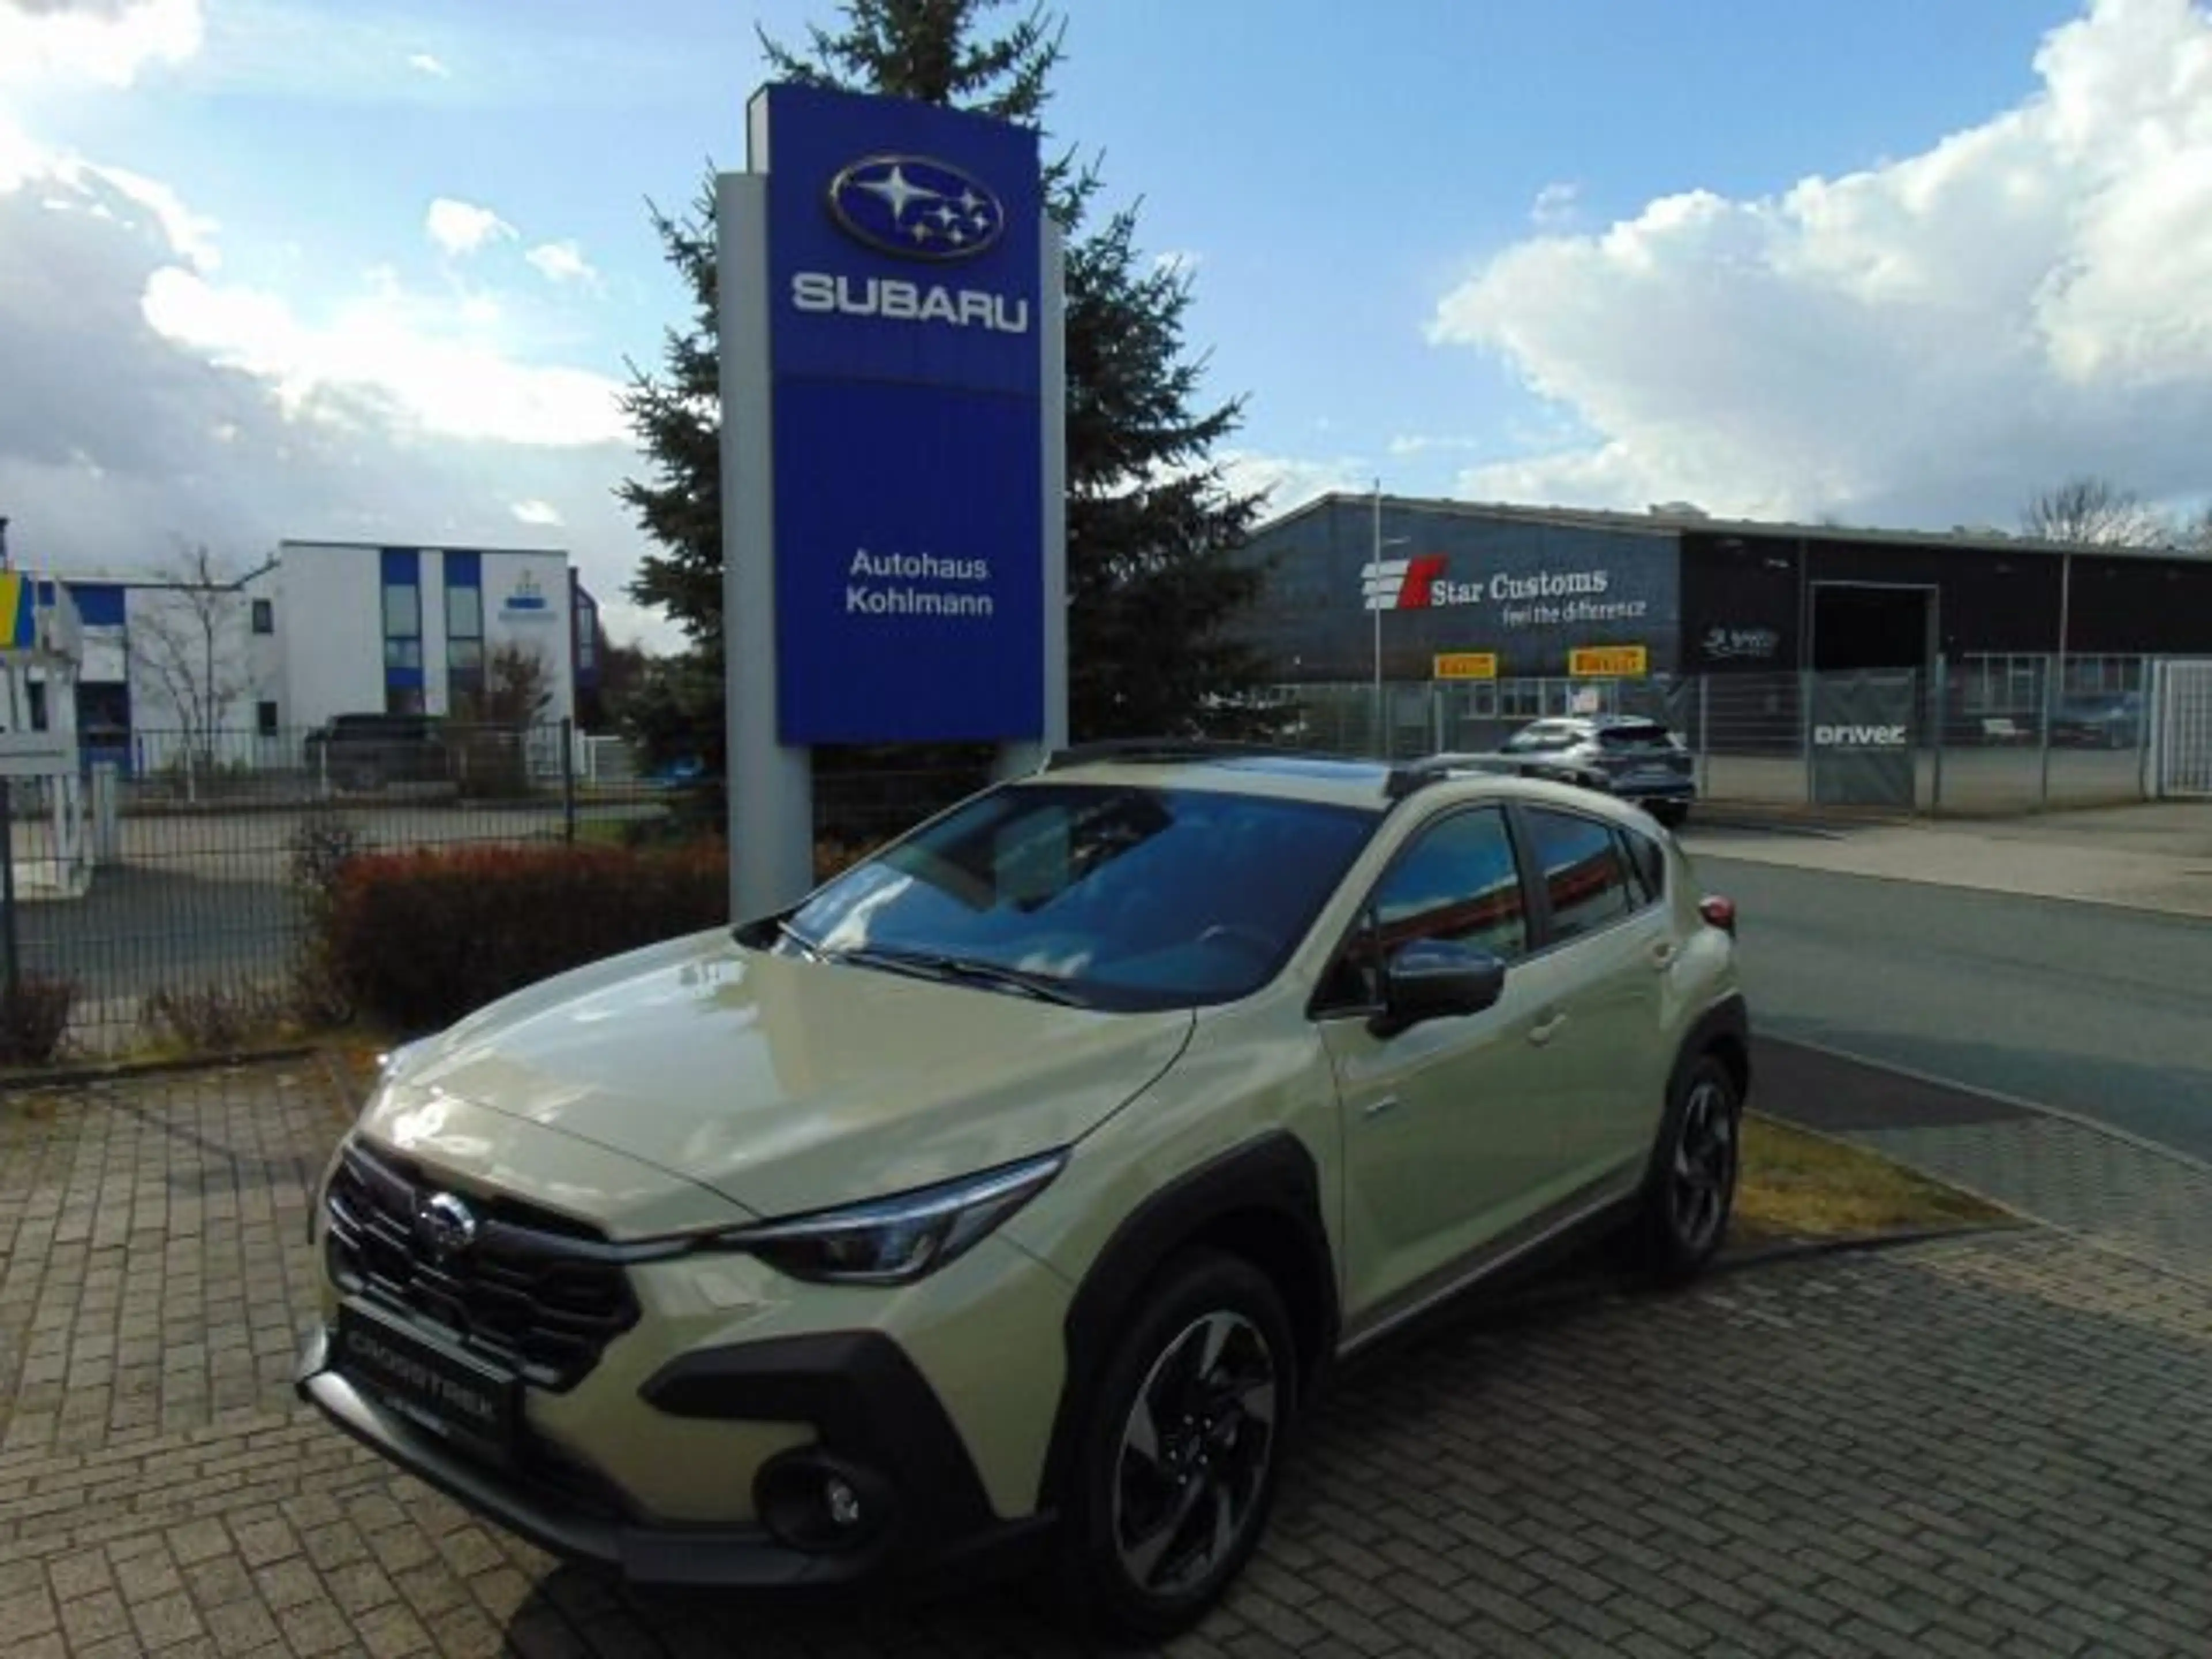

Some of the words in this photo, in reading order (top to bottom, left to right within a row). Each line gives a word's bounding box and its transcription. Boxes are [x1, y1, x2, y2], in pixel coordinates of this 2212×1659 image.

[791, 271, 1028, 334] SUBARU
[849, 547, 990, 579] Autohaus
[846, 585, 994, 616] Kohlmann
[1431, 578, 1484, 607] Star
[1490, 569, 1608, 601] Customs
